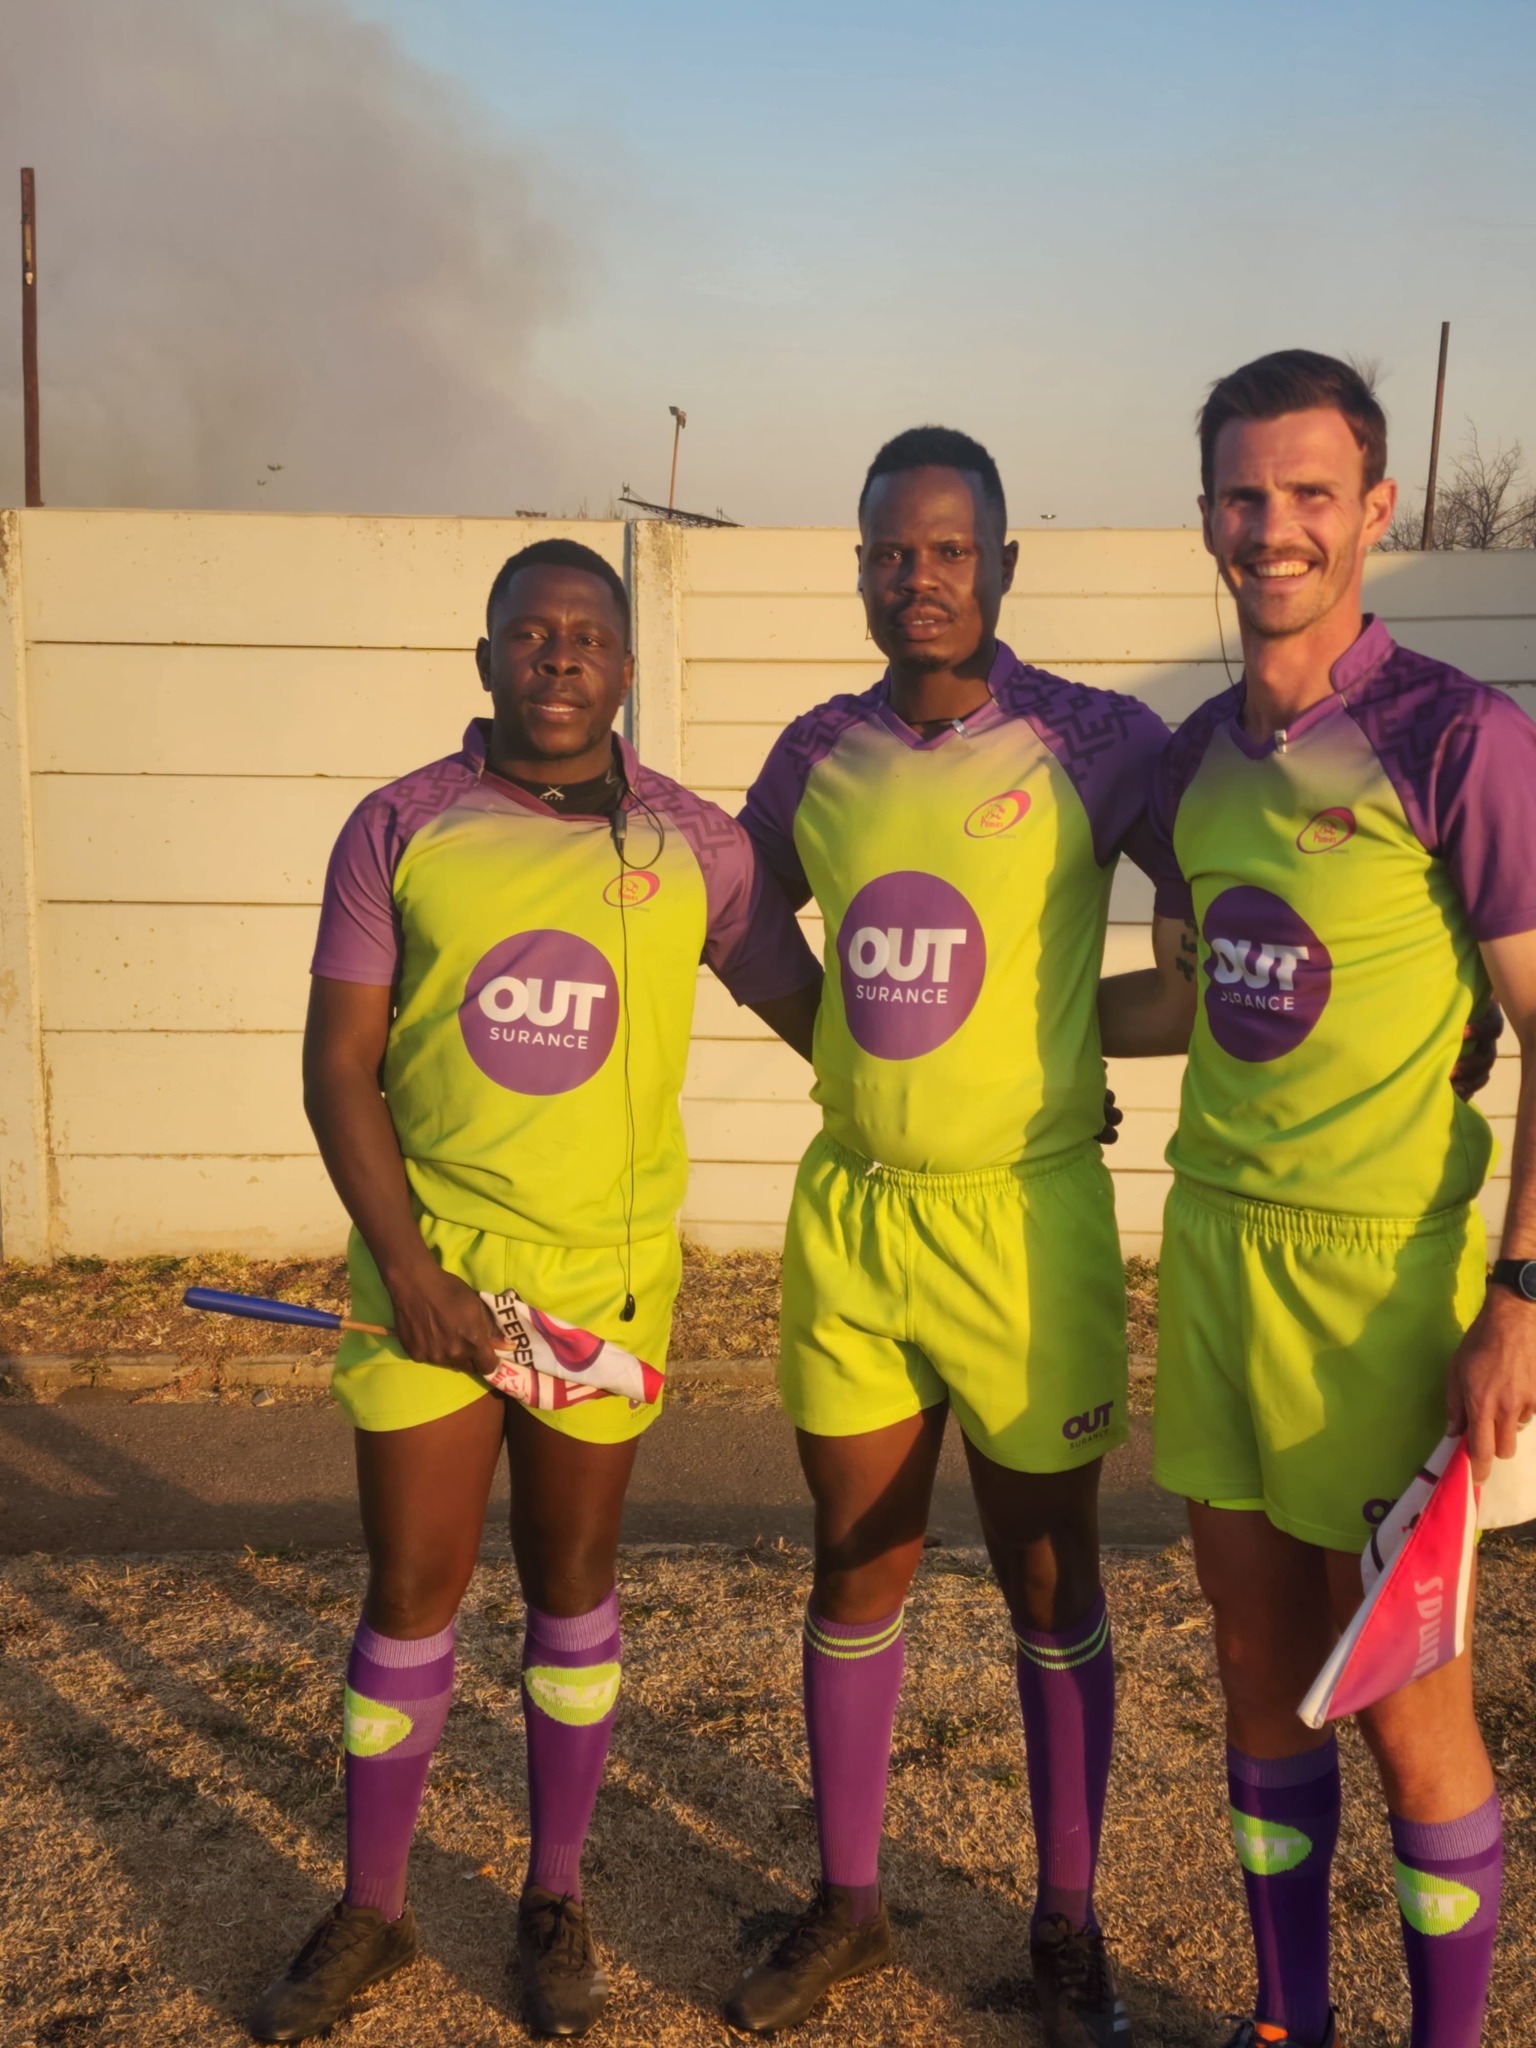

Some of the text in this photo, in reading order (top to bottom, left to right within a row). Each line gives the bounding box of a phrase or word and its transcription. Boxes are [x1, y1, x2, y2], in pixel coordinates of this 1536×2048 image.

[848, 927, 967, 982] OUT
[1211, 938, 1310, 991] OUT
[478, 976, 606, 1031] OUT
[856, 985, 949, 1004] SURANCE
[489, 1027, 589, 1050] SURANCE
[1062, 1400, 1114, 1440] OUT
